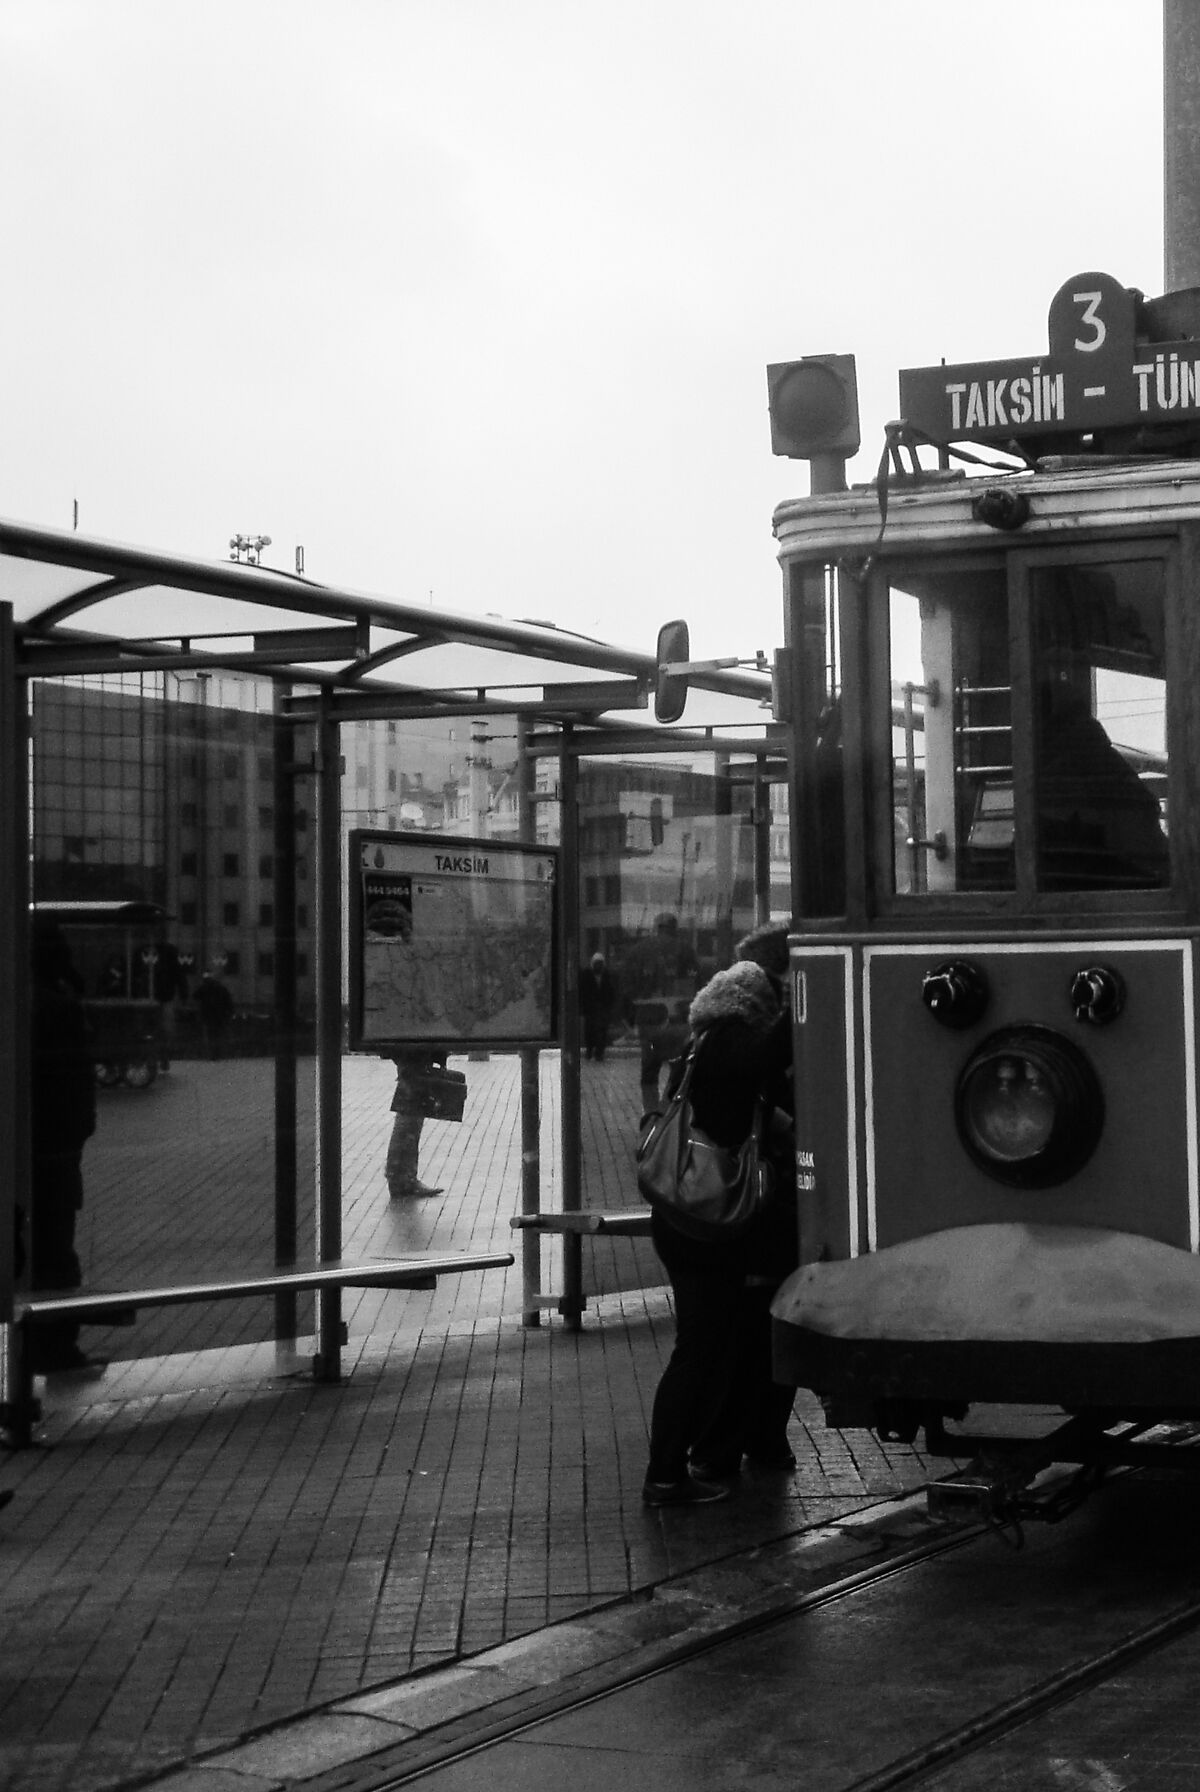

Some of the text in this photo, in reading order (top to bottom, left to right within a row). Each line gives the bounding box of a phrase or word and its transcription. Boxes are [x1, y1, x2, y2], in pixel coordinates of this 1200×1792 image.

[1072, 290, 1107, 353] 3
[945, 366, 1065, 430] TAKSİM
[435, 854, 489, 874] TAKSİM
